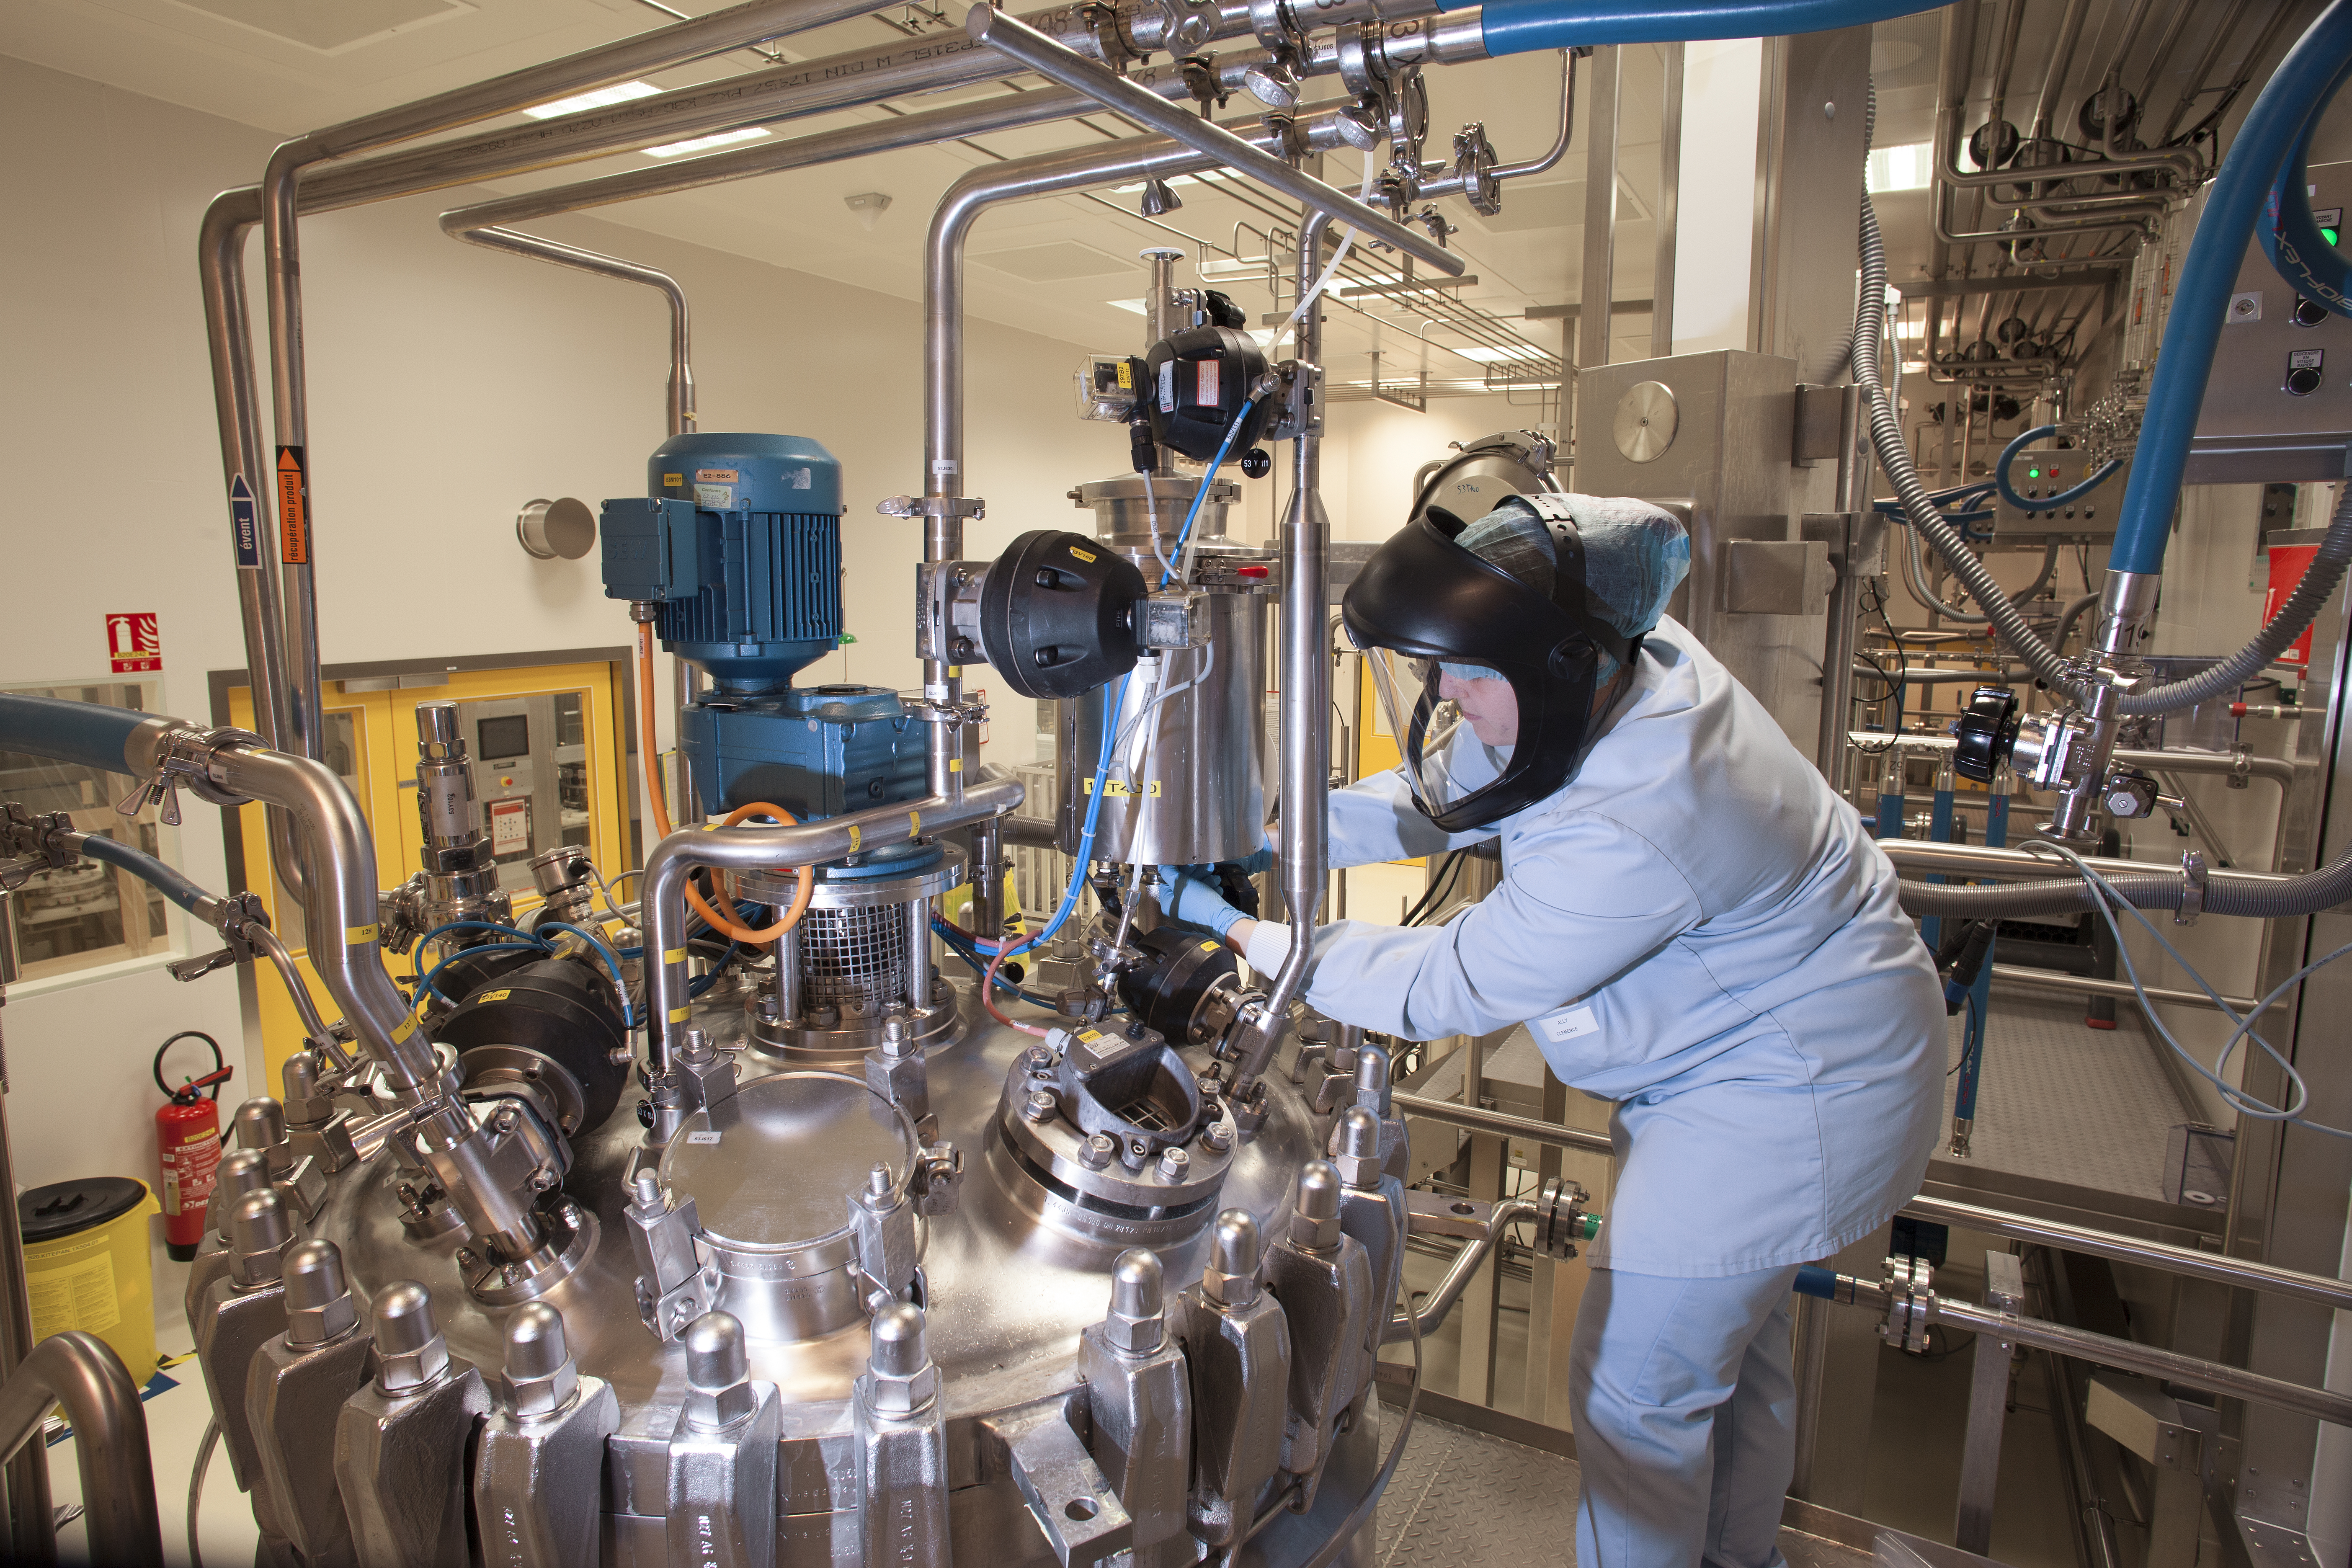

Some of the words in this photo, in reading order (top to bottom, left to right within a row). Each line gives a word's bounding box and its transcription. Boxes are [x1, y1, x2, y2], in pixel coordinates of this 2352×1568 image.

[1227, 420, 1239, 440] 53V111
[284, 474, 297, 504] produit
[239, 517, 253, 550] évent
[287, 507, 299, 561] récupération
[609, 538, 648, 560] SEW
[1087, 781, 1157, 794] 1T400
[361, 928, 372, 936] 128
[404, 1019, 413, 1030] 127
[1556, 1026, 1578, 1036] CLEMENCE
[1081, 1032, 1099, 1042] 53A193
